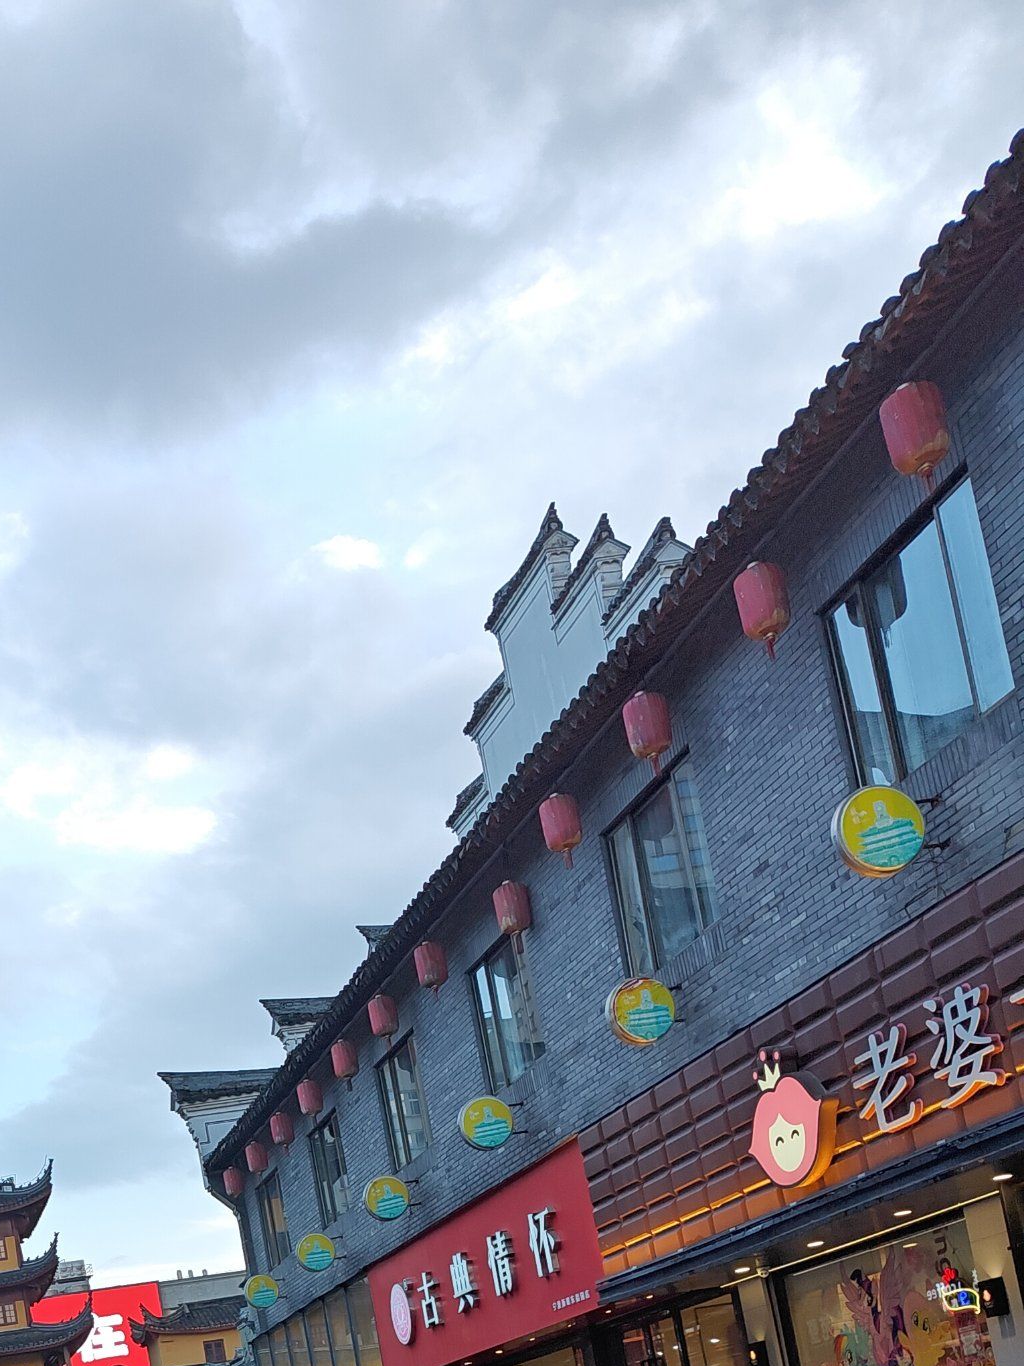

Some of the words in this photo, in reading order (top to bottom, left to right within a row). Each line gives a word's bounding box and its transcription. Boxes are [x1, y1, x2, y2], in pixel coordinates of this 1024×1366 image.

[853, 984, 1024, 1132] 老婆
[417, 1206, 557, 1329] 古典情怀
